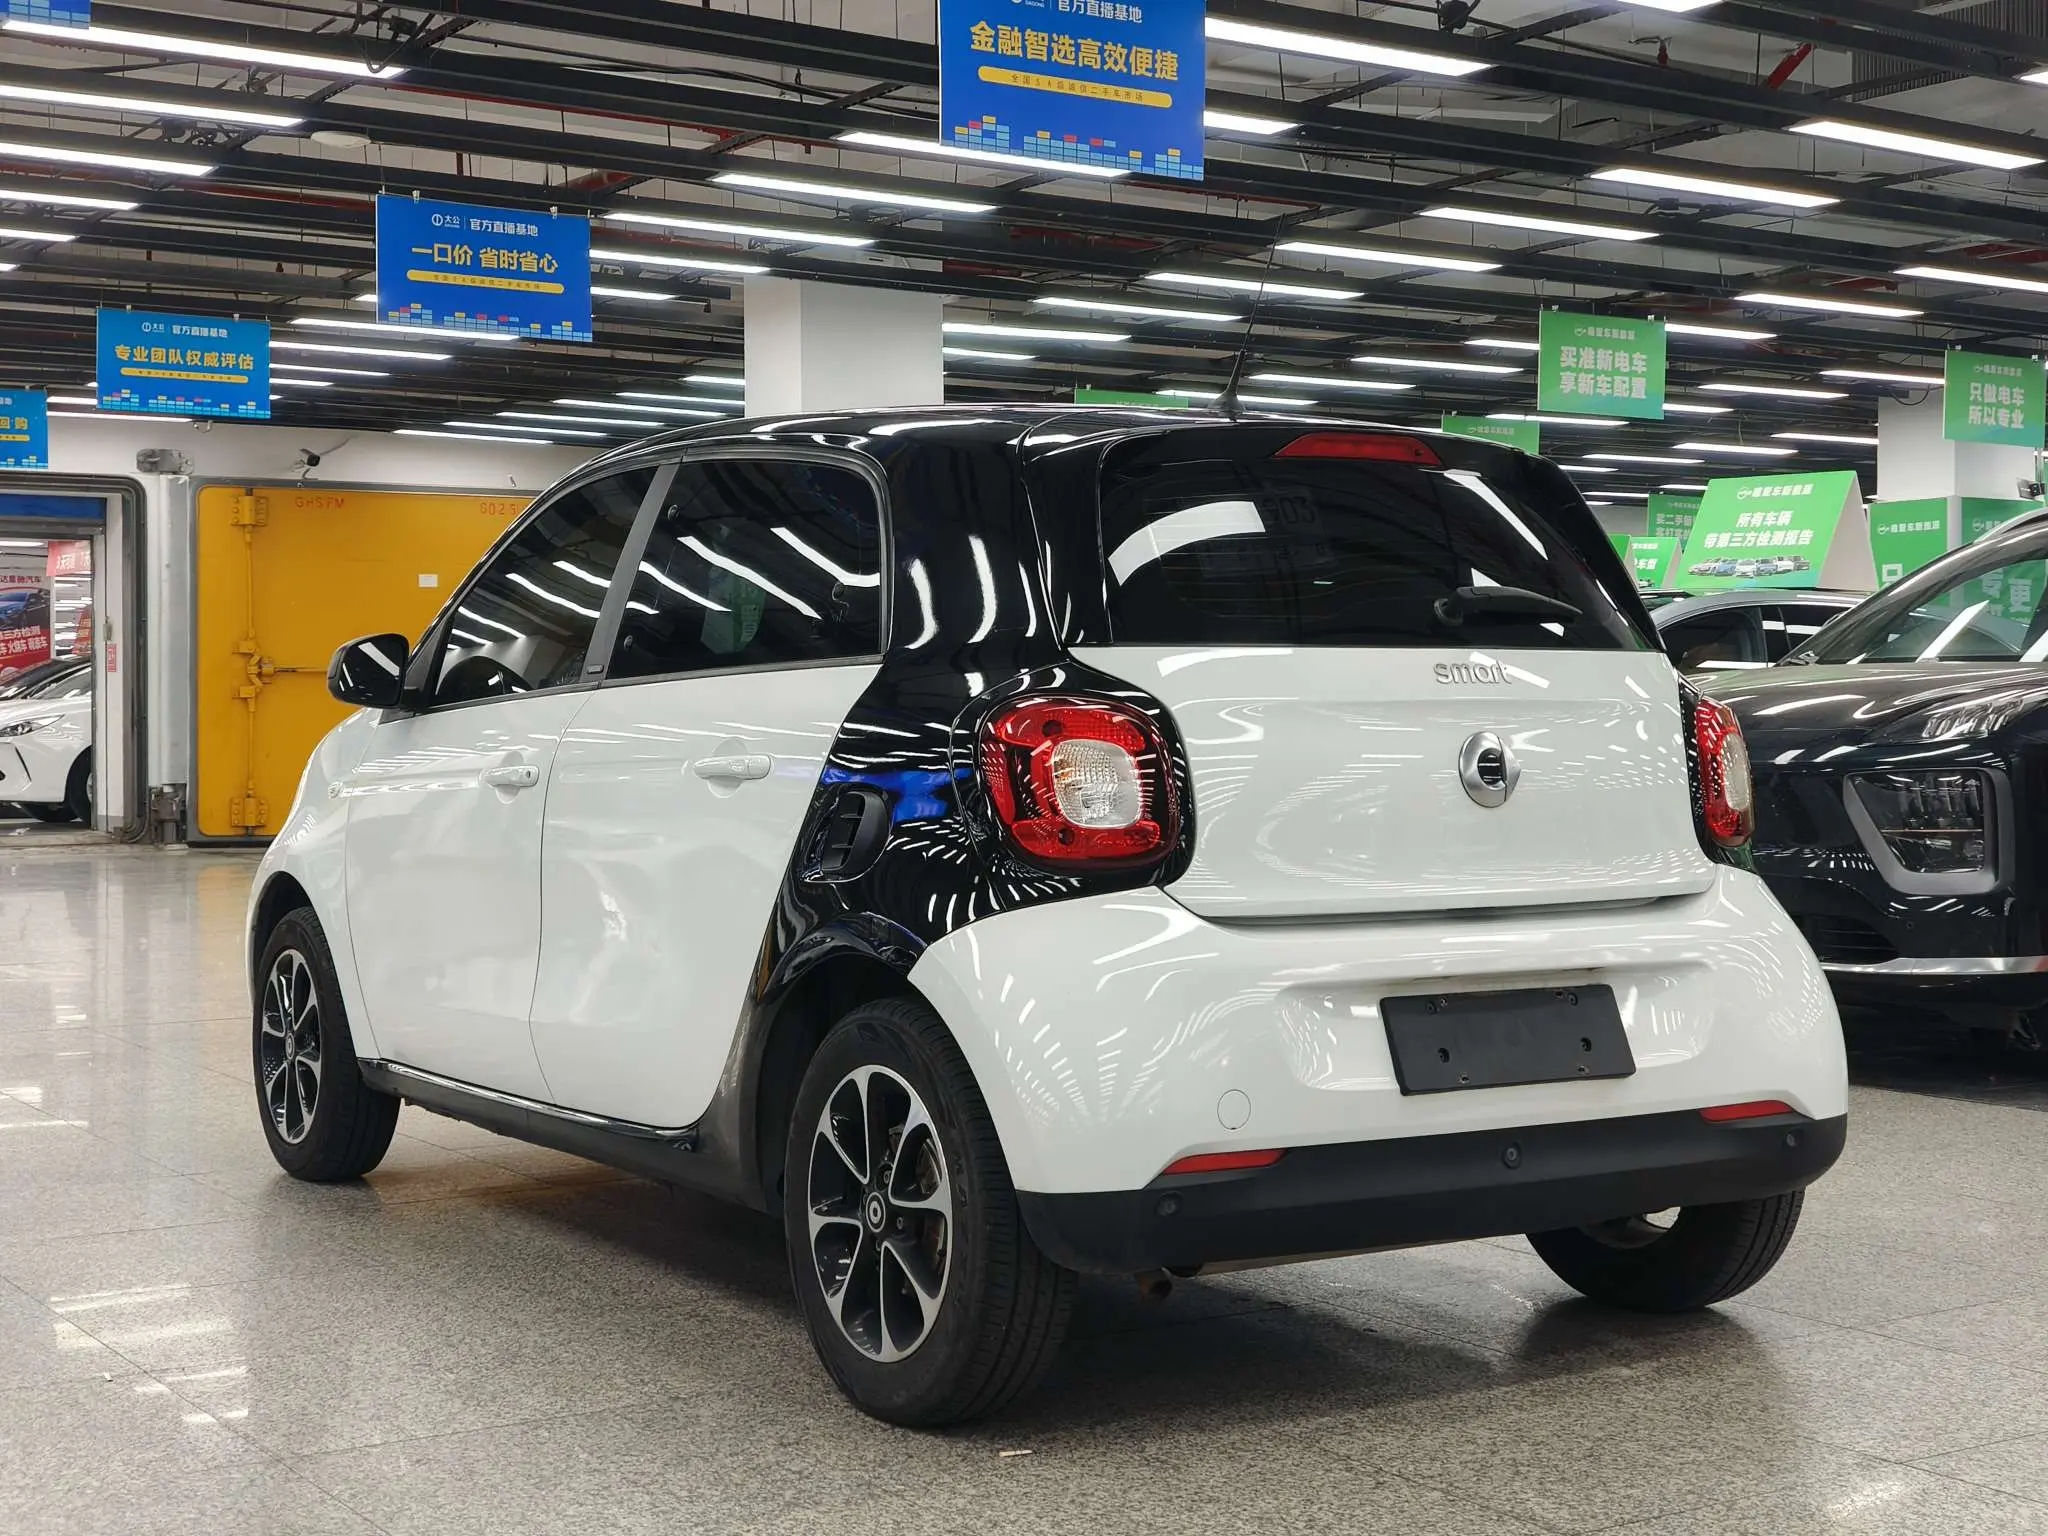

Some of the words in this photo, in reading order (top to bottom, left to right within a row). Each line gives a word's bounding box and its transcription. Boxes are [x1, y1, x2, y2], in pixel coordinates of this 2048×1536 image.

[1058, 0, 1143, 24] 官方直播基地
[969, 20, 1179, 81] 金融智选高效便捷
[470, 218, 538, 237] 官方直播基地
[411, 243, 473, 266] 一口价
[479, 247, 559, 274] 省时省心
[114, 344, 254, 370] 专业团队权威评估
[1560, 346, 1648, 374] 买准新电车
[1559, 371, 1647, 399] 享新车配置
[1736, 510, 1794, 528] 所有车辆
[1704, 529, 1814, 549] 带第三方检测报告
[0, 626, 41, 640] 三方检测
[1434, 660, 1512, 685] smart
